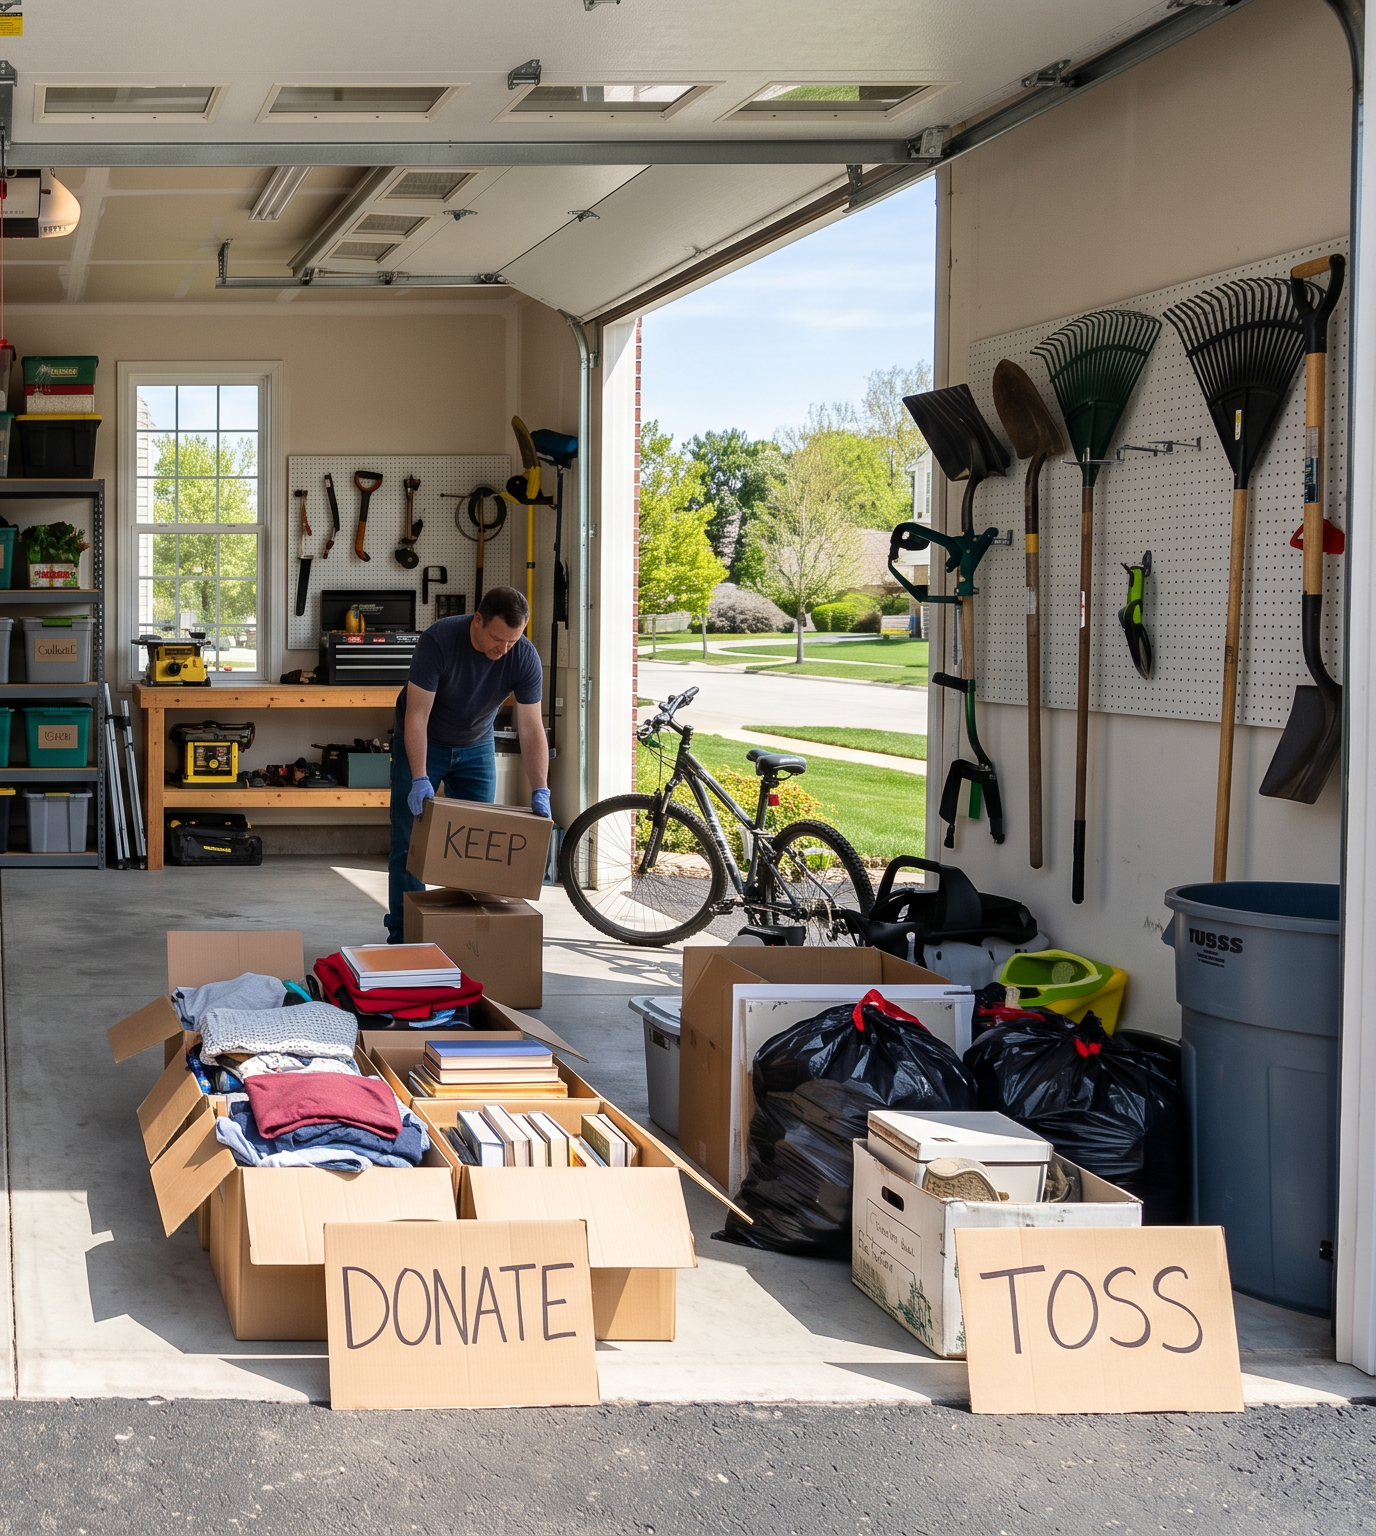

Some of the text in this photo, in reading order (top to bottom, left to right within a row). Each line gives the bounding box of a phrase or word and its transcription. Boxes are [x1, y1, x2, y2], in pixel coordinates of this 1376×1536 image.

[443, 821, 528, 867] KEEP
[1189, 928, 1243, 954] TUSSS
[341, 1262, 577, 1350] DONATE
[979, 1265, 1204, 1355] TOSS
